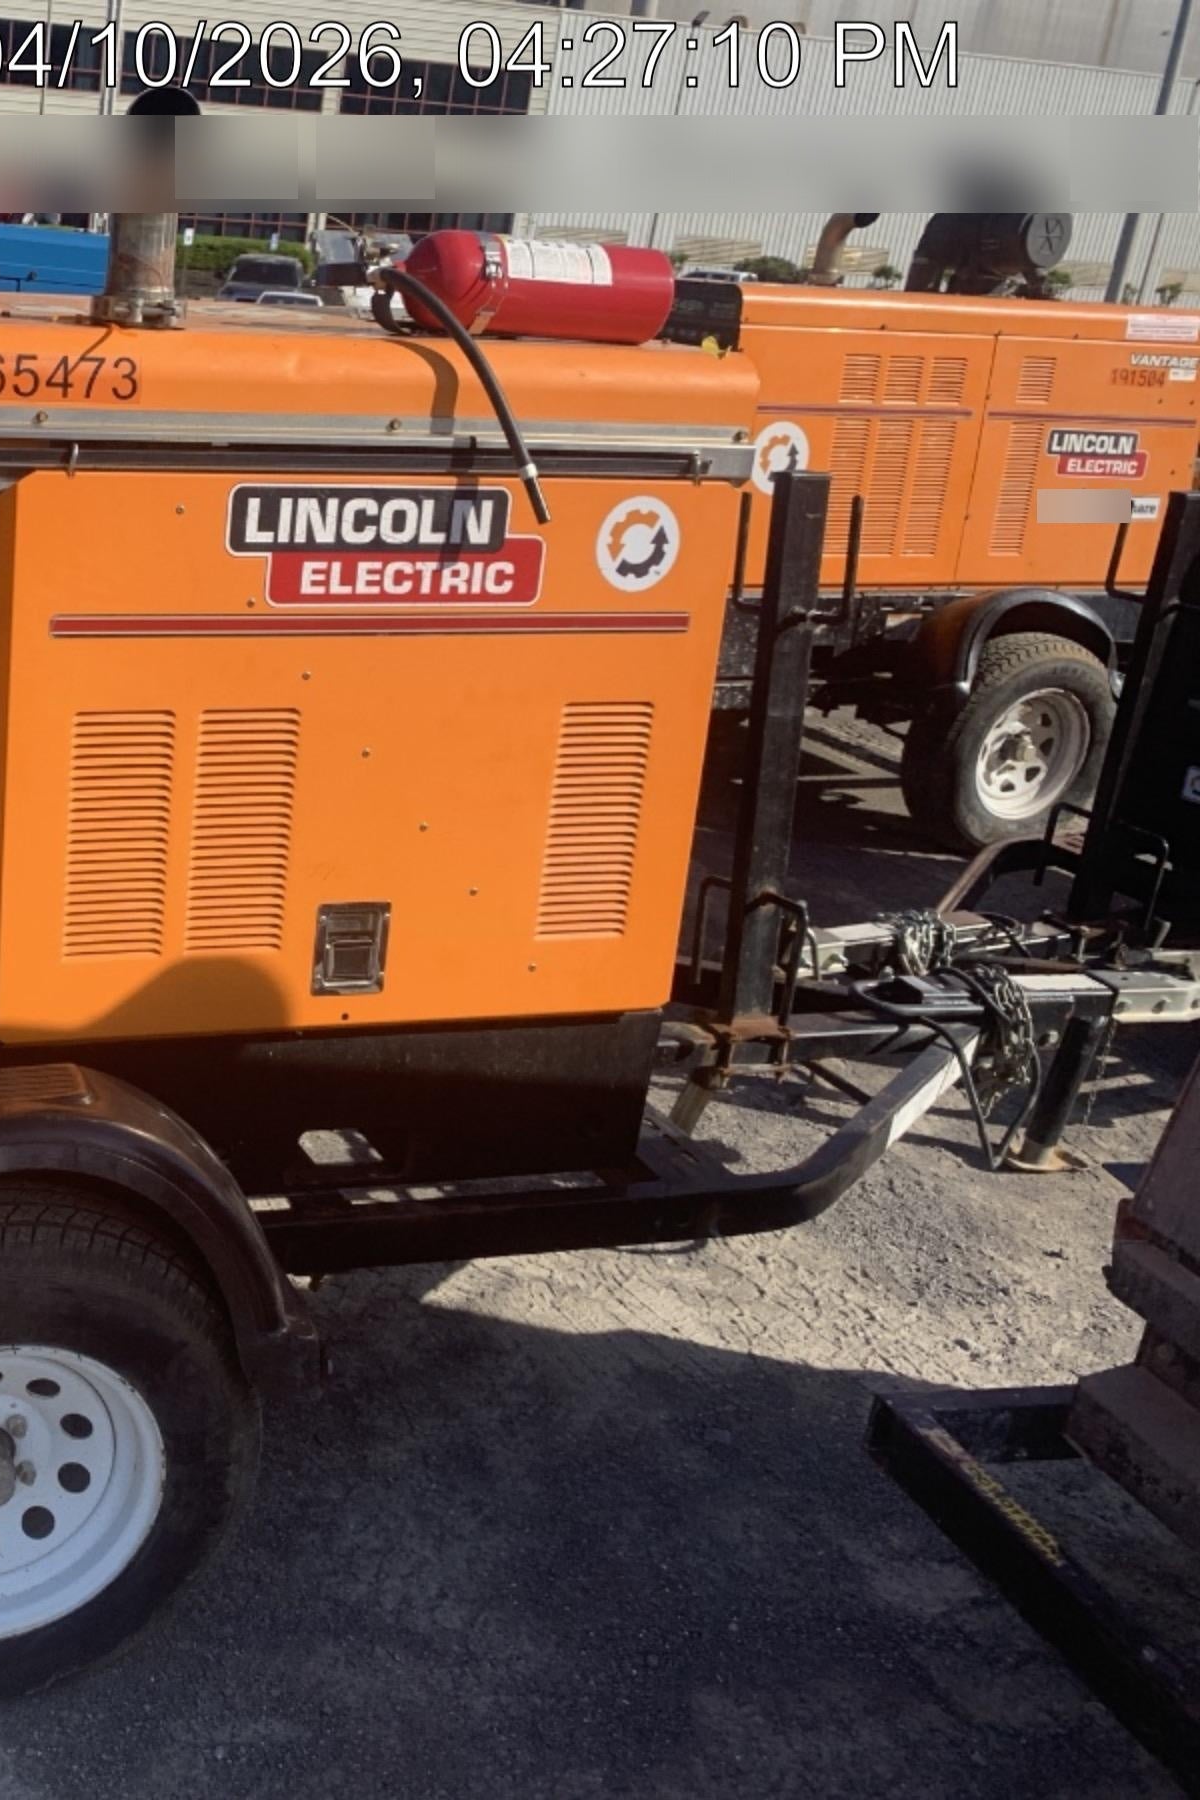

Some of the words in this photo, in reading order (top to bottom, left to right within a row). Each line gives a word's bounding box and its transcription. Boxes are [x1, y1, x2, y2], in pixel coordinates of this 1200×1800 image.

[1051, 432, 1134, 455] LINCOLN
[1067, 458, 1138, 475] ELECTRIC
[244, 497, 495, 545] LINCOLN
[300, 561, 516, 596] ELECTRIC
